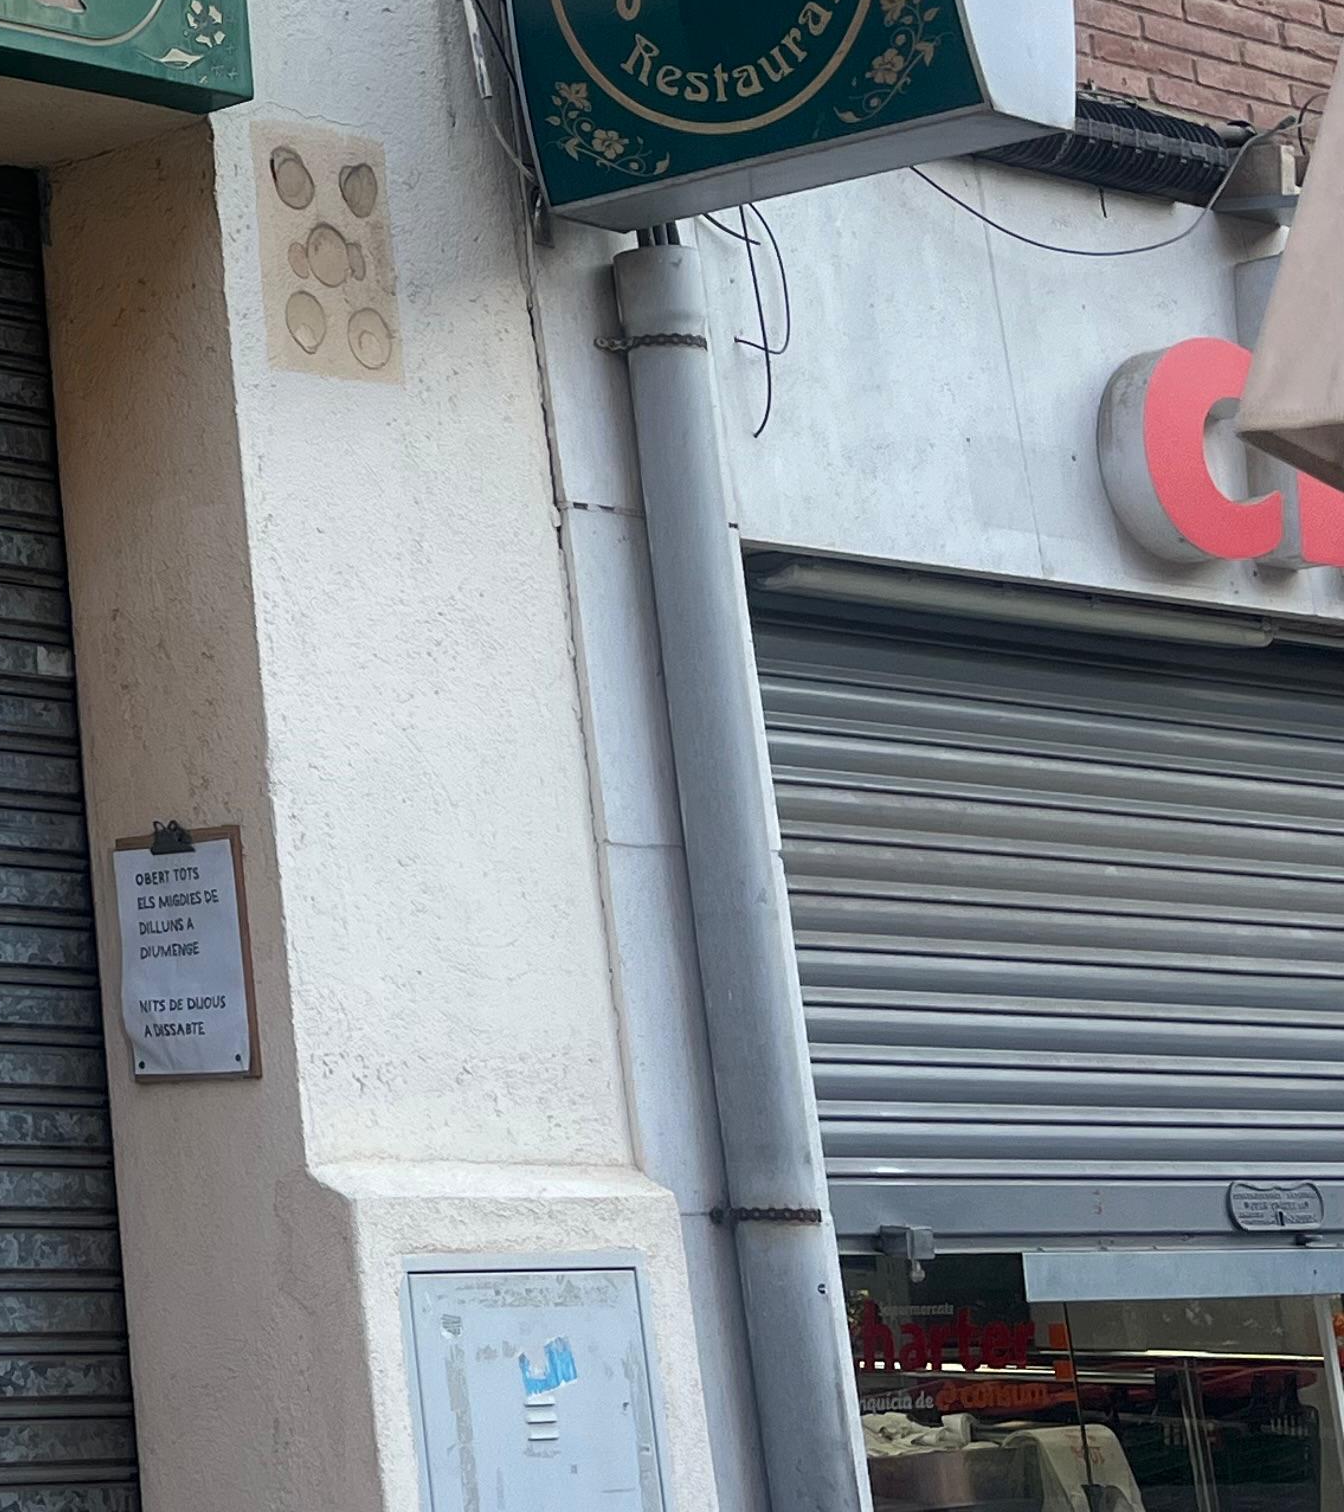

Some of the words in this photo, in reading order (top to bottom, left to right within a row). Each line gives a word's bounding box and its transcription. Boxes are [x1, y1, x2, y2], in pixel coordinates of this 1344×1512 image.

[135, 870, 170, 886] OBERT
[173, 867, 200, 882] TOTS
[137, 896, 155, 910] ELS
[158, 891, 202, 908] MIGDIES
[204, 889, 219, 903] DE
[139, 918, 184, 935] DILLUNS
[186, 917, 195, 930] A
[140, 941, 200, 960] DIUMENGE
[139, 999, 166, 1013] NITS
[169, 998, 184, 1011] DE
[186, 995, 226, 1009] DIJOUS
[144, 1024, 152, 1037] A
[153, 1021, 206, 1037] DISSABTE
[857, 1298, 1036, 1372] harter
[915, 1390, 934, 1408] de
